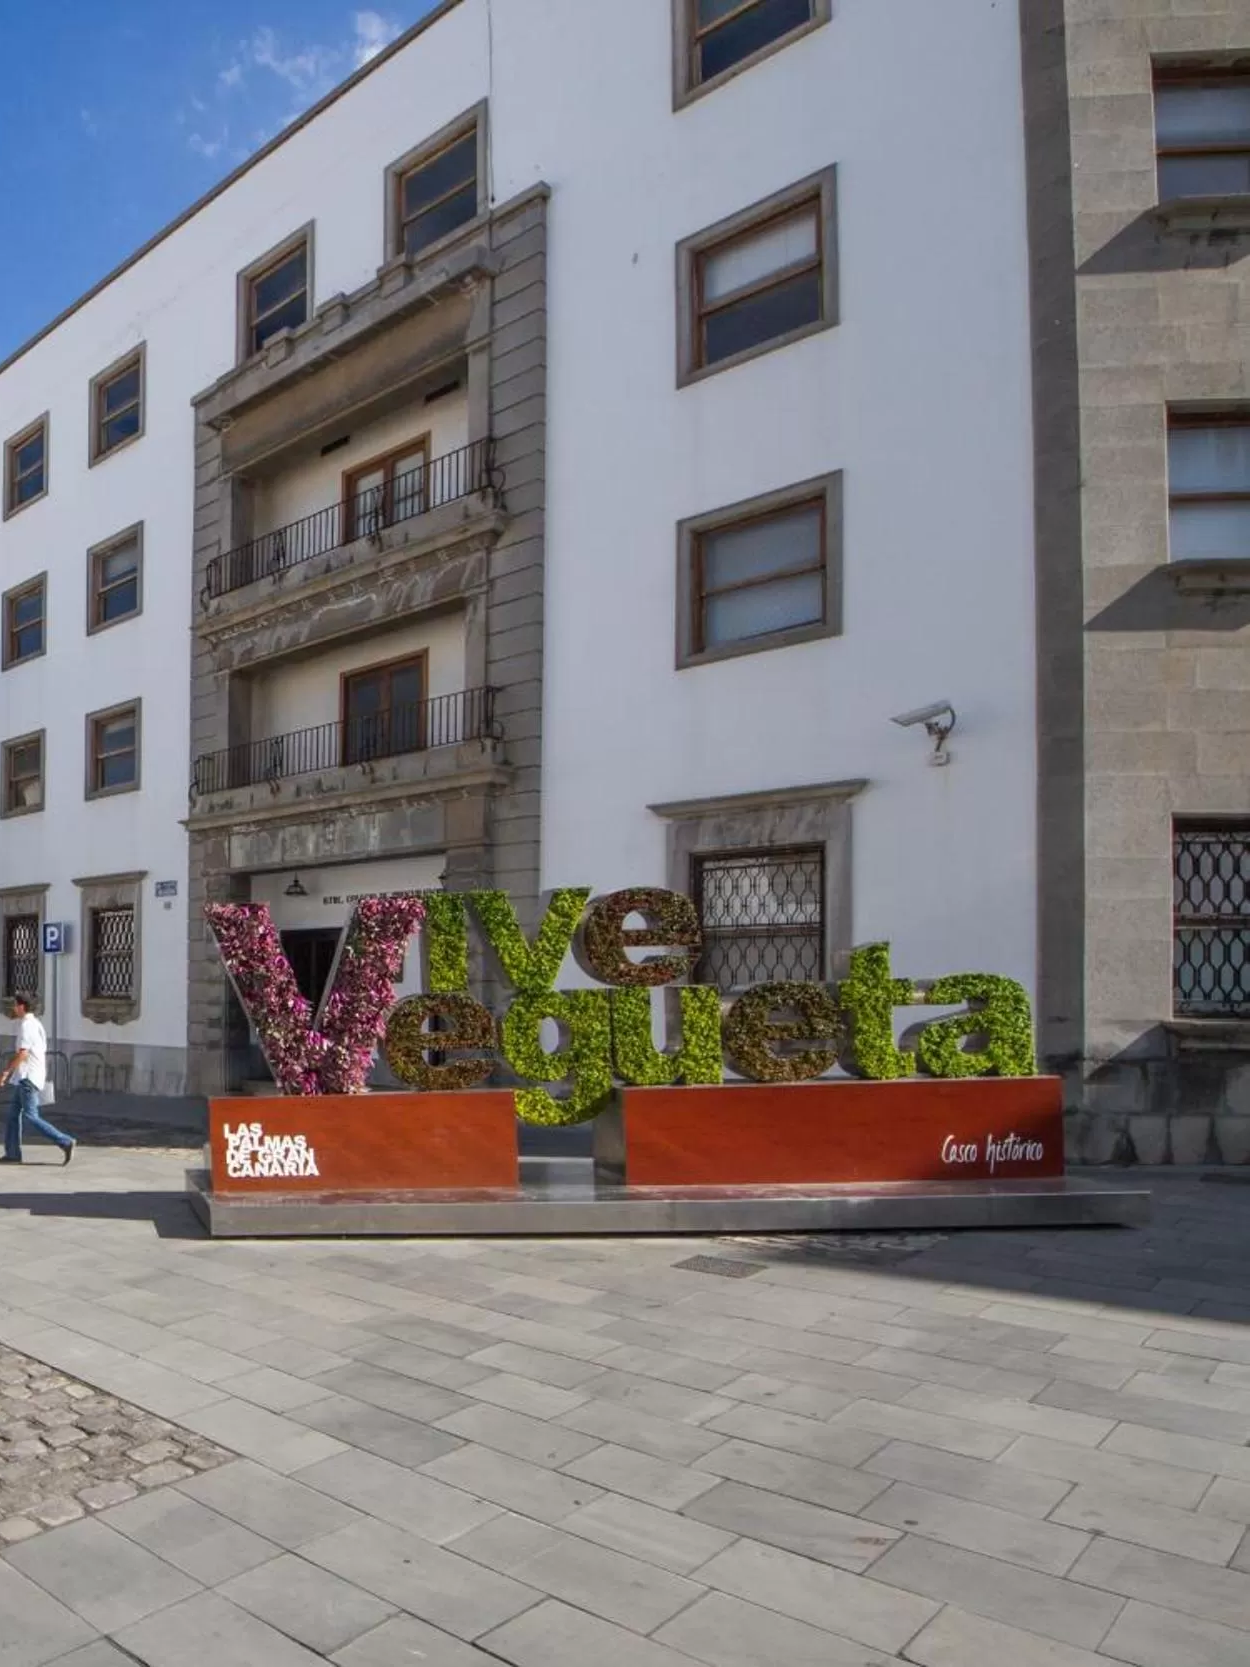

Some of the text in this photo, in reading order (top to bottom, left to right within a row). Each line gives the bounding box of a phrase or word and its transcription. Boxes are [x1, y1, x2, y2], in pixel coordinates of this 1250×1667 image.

[46, 926, 59, 949] P
[203, 896, 1037, 1127] Vegueta
[224, 1123, 263, 1139] LAS
[227, 1134, 307, 1151] PALMAS
[226, 1147, 315, 1164] DE GRAN
[941, 1132, 1044, 1175] Casco histórico
[228, 1160, 320, 1177] CANARIA
